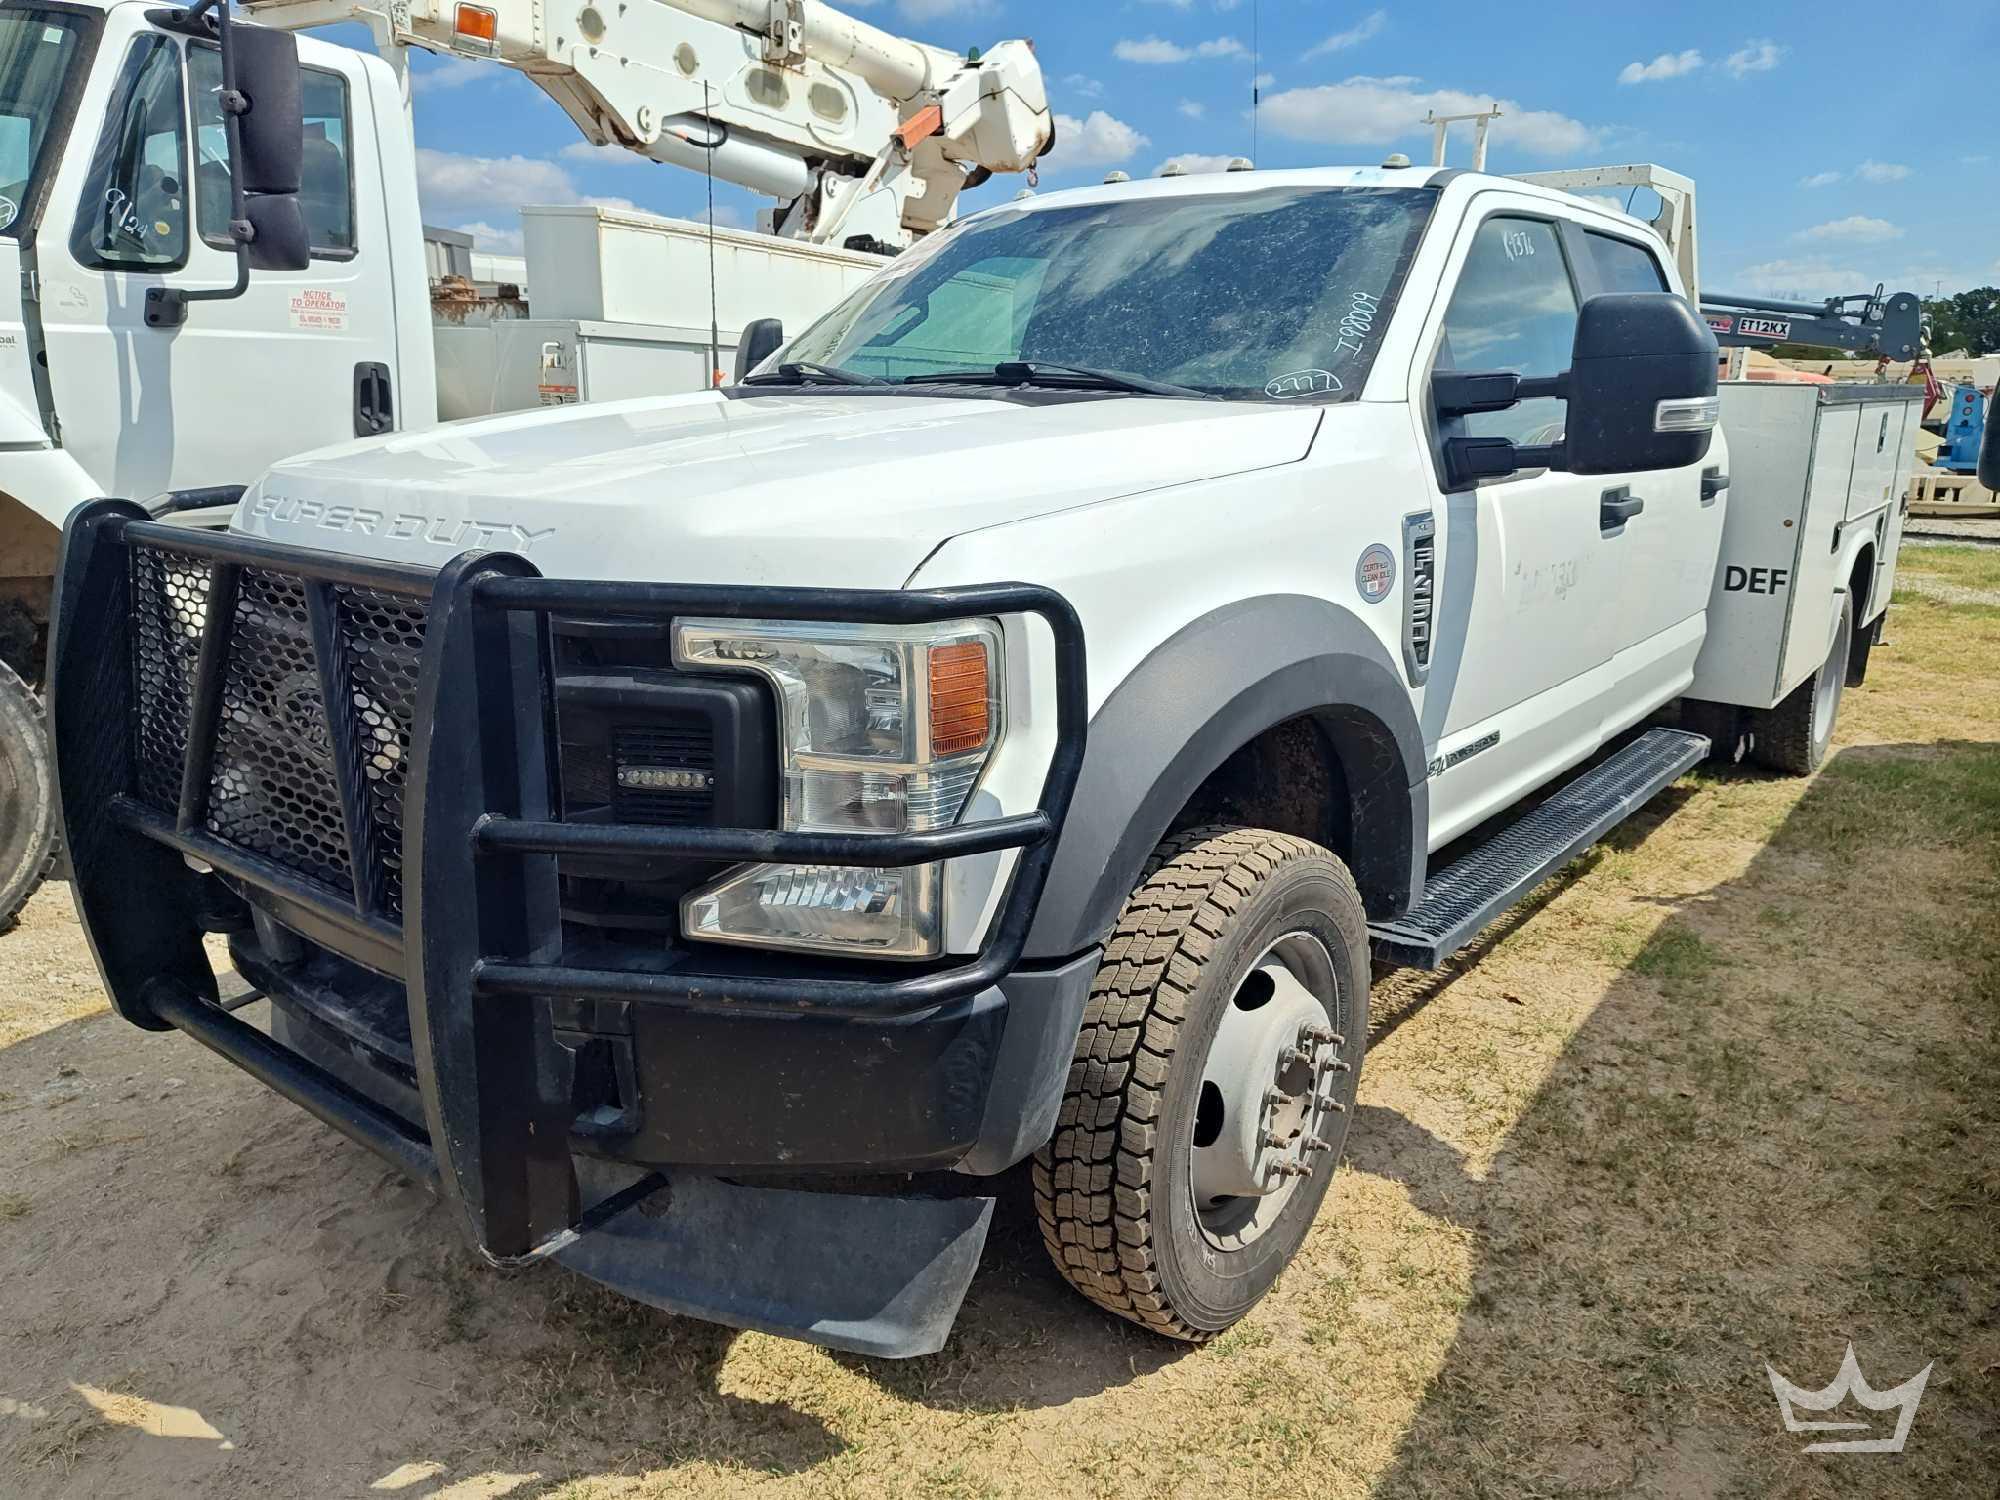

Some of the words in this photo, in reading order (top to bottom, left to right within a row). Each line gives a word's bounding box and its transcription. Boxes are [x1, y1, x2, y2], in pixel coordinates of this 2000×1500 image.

[291, 298, 303, 306] TO
[304, 300, 346, 311] OPERATOR
[1740, 319, 1788, 335] ET12KX
[251, 495, 384, 536] SUPER
[384, 511, 557, 555] DUTY
[1723, 565, 1788, 596] DEF
